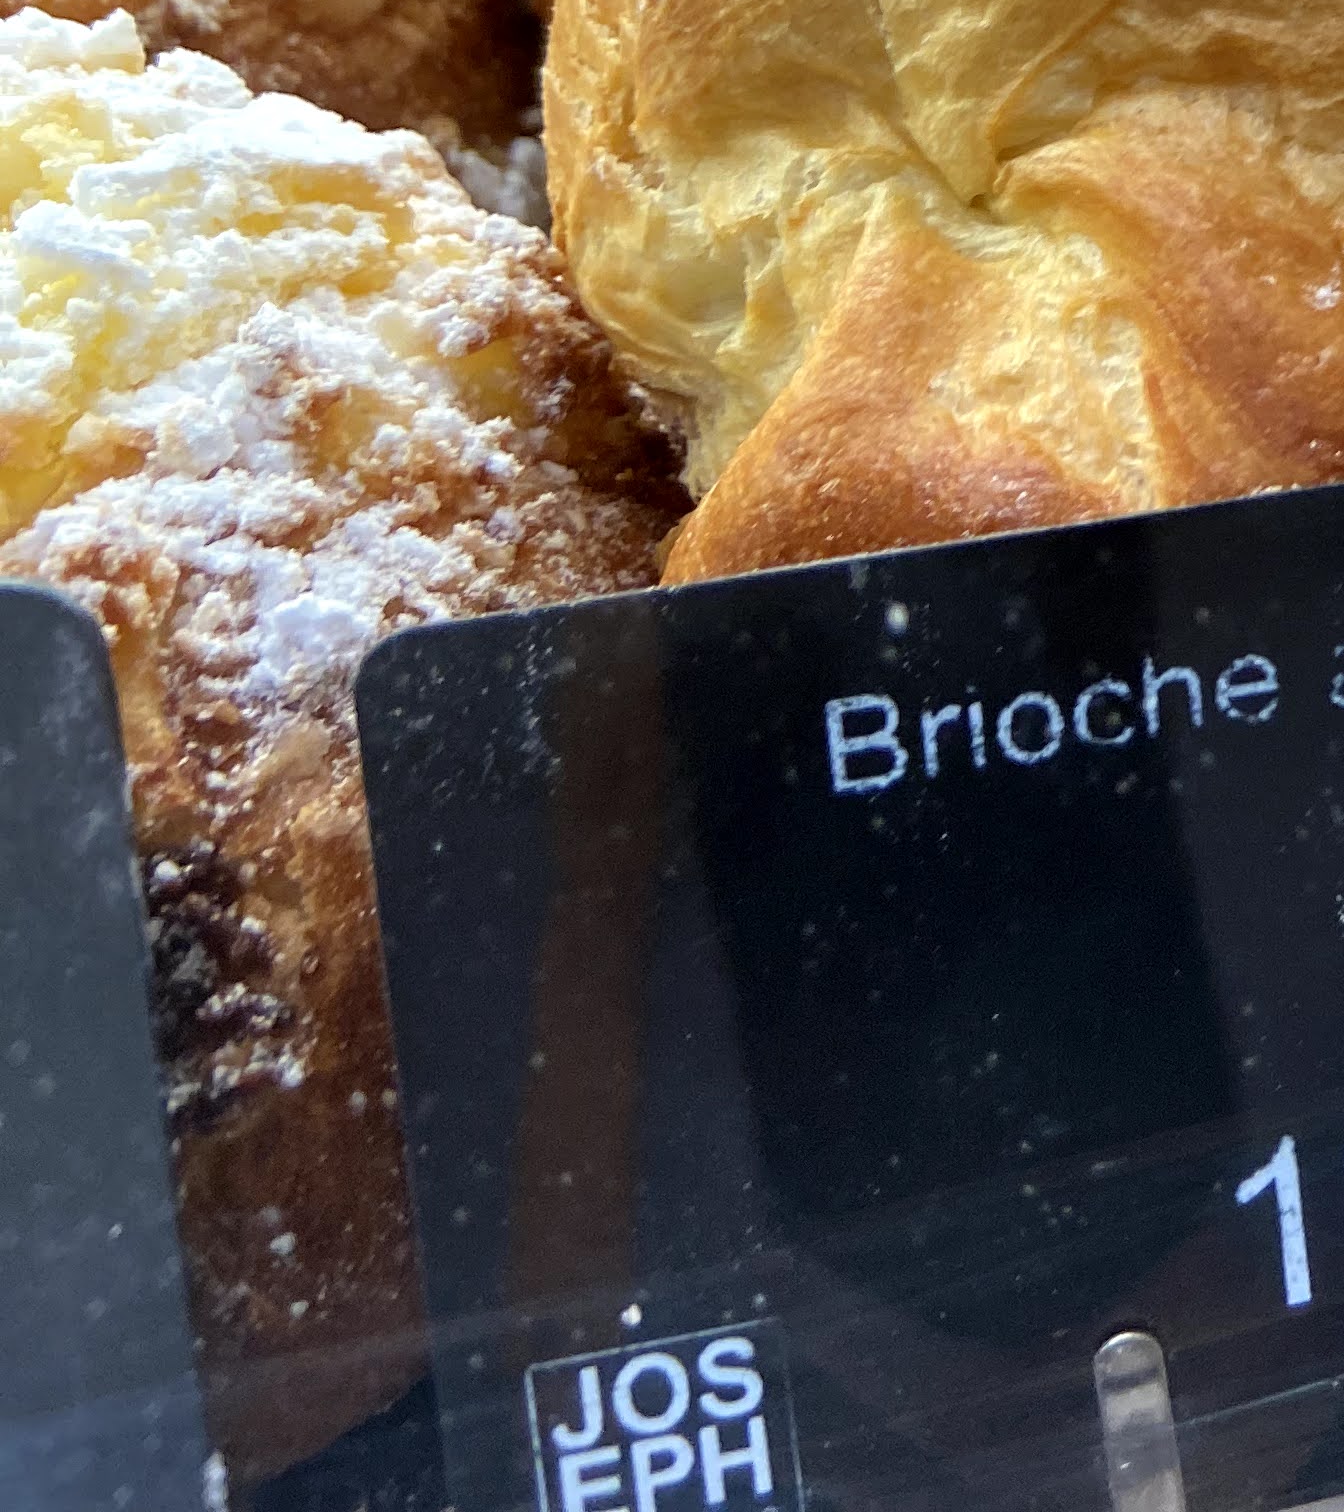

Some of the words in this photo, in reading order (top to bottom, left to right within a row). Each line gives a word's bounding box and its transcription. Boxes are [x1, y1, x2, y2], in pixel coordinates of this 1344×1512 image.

[825, 654, 1280, 794] Brioche
[1235, 1134, 1312, 1306] 1
[551, 1336, 764, 1450] JOS
[558, 1414, 773, 1512] EPH
